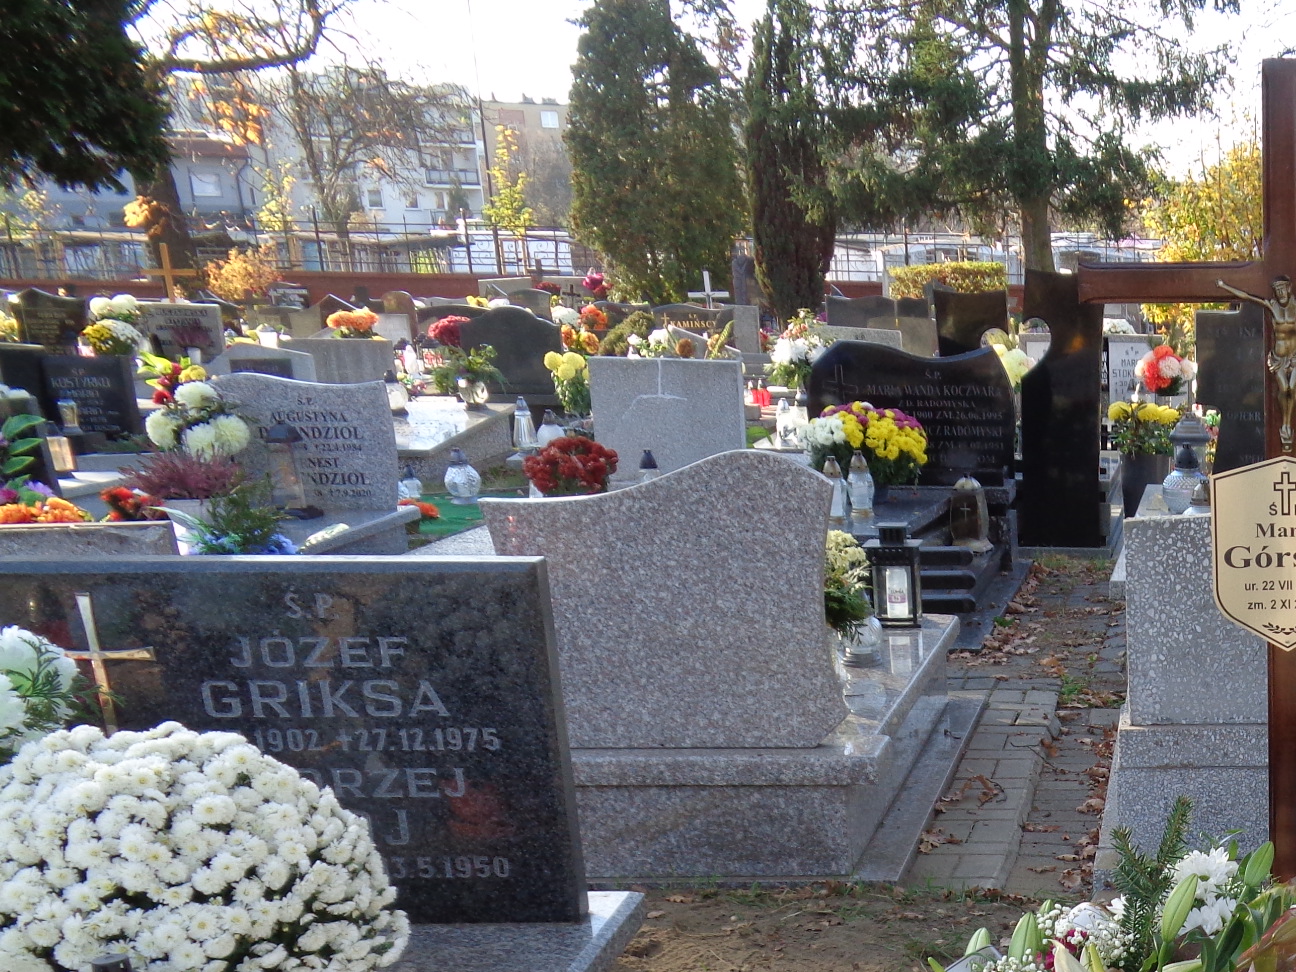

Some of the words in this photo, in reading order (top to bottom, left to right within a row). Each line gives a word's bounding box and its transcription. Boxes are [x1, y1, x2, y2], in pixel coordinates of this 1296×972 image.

[904, 385, 941, 397] WANDA
[1268, 502, 1278, 516] Ś
[1244, 582, 1259, 591] ur.
[1262, 580, 1275, 591] 22
[1278, 580, 1293, 591] VII
[1247, 601, 1267, 610] zm.
[1270, 599, 1277, 610] 2
[1280, 599, 1291, 610] XI
[229, 629, 408, 668] JÓZEF
[200, 679, 451, 719] GRIKSA
[253, 728, 320, 751] 1902
